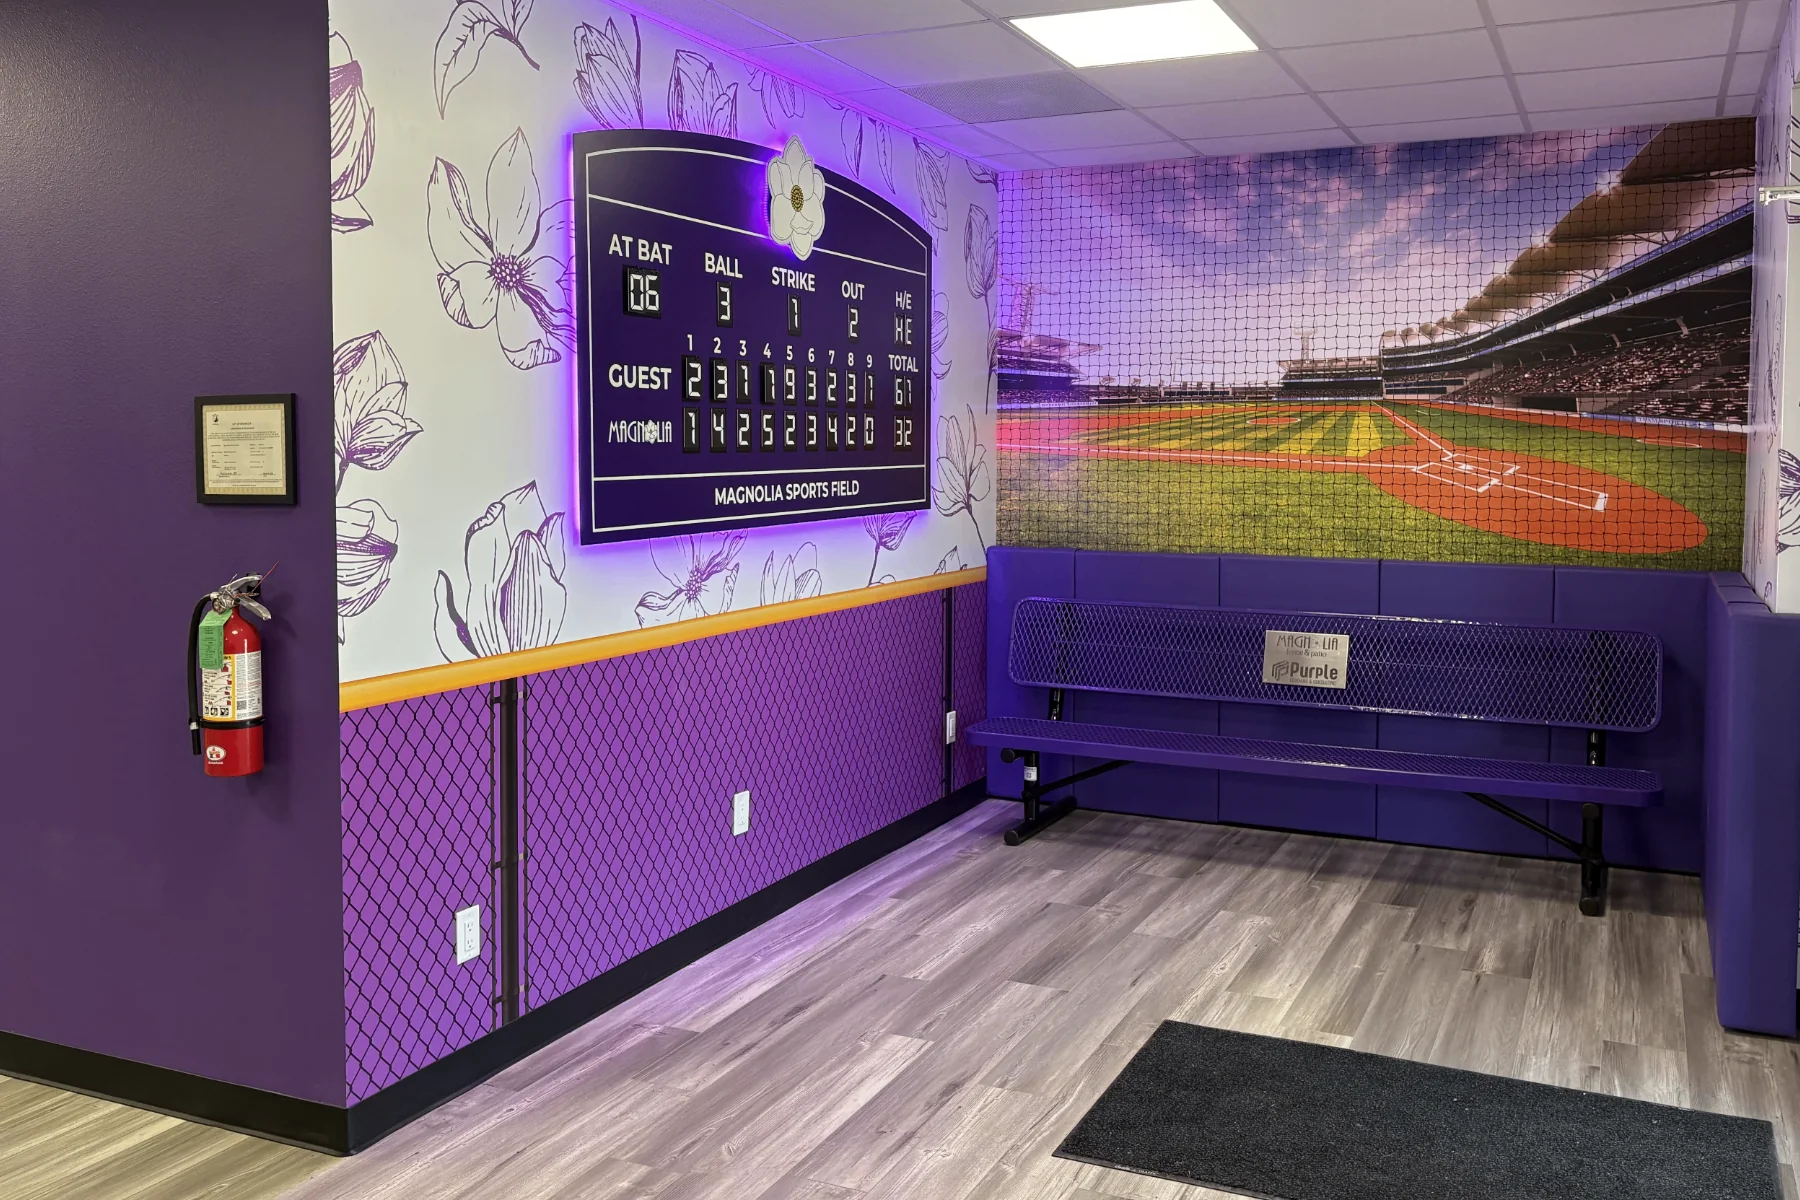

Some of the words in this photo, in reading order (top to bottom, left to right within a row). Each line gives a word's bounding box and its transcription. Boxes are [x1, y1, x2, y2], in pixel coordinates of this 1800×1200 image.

[609, 234, 633, 258] AT
[638, 239, 672, 265] BAT
[705, 252, 743, 278] BALL
[630, 274, 659, 311] 06
[771, 266, 816, 292] STRIKE
[841, 280, 865, 300] OUT
[720, 286, 731, 320] 3
[791, 298, 799, 328] 1
[896, 290, 912, 310] H/E
[850, 308, 858, 337] 2
[687, 334, 692, 351] 1
[714, 337, 721, 354] 2
[739, 340, 747, 356] 3
[763, 343, 771, 358] 4
[786, 345, 793, 361] 5
[808, 348, 815, 362] 6
[828, 350, 835, 364] 7
[848, 352, 854, 366] 8
[866, 354, 872, 368] 9
[888, 354, 918, 372] TOTAL
[609, 363, 672, 390] GUEST
[688, 362, 701, 396] 2
[716, 366, 727, 398] 3
[741, 365, 748, 396] 1
[768, 370, 775, 399] 1
[786, 369, 795, 399] 9
[808, 370, 816, 400] 3
[828, 372, 836, 401] 2
[848, 373, 856, 402] 3
[868, 376, 873, 402] 1
[688, 412, 695, 444] 1
[713, 414, 724, 444] 4
[739, 414, 750, 445] 2
[763, 414, 773, 445] 5
[786, 415, 795, 445] 2
[808, 415, 816, 445] 3
[828, 416, 838, 445] 4
[848, 416, 856, 445] 2
[866, 417, 873, 445] 0
[714, 484, 784, 505] MAGNOLIA
[786, 481, 828, 500] SPORTS
[831, 480, 859, 496] FIELD
[1311, 650, 1327, 658] patio
[1290, 662, 1338, 680] Purple
